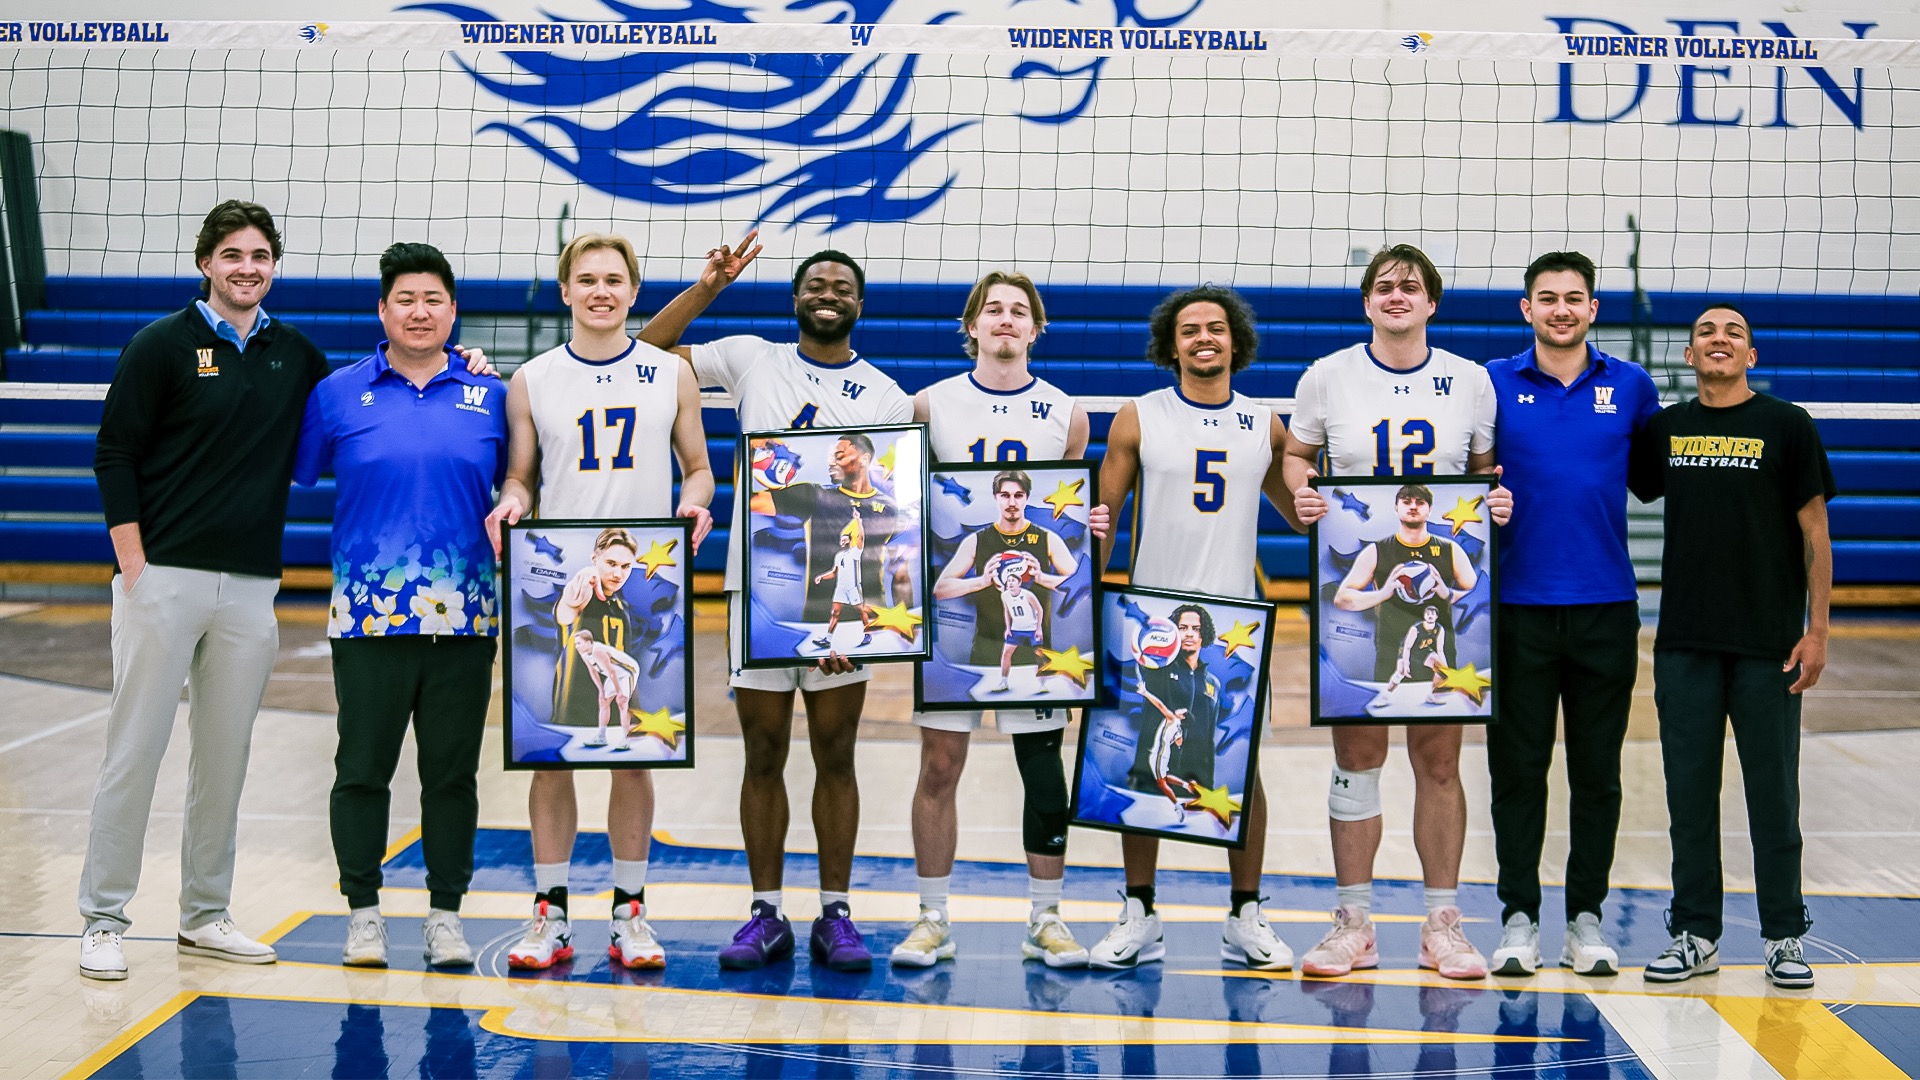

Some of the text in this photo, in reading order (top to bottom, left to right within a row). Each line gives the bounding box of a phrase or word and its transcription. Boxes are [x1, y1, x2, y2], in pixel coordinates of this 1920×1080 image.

[29, 23, 169, 42] VOLLEYBALL
[461, 24, 717, 45] WIDENER VOLLEYBALL
[850, 25, 876, 46] W
[1008, 28, 1267, 50] WIDENER VOLLEYBALL
[1565, 36, 1818, 60] WIDENER VOLLEYBALL
[1543, 17, 1878, 132] DEN
[196, 349, 213, 367] W
[635, 364, 657, 384] W
[463, 385, 488, 406] W
[841, 379, 867, 401] W
[1433, 376, 1454, 396] W
[1594, 386, 1614, 404] W
[1030, 400, 1053, 420] W
[1236, 412, 1254, 431] W
[576, 405, 637, 472] 17
[1371, 417, 1437, 476] 12
[1670, 435, 1764, 459] WIDENER
[1668, 456, 1759, 469] VOLLEYBALL
[1192, 448, 1228, 514] 5
[1027, 533, 1039, 544] W
[1430, 545, 1440, 557] W
[535, 568, 561, 578] DAHL
[602, 615, 625, 651] 17
